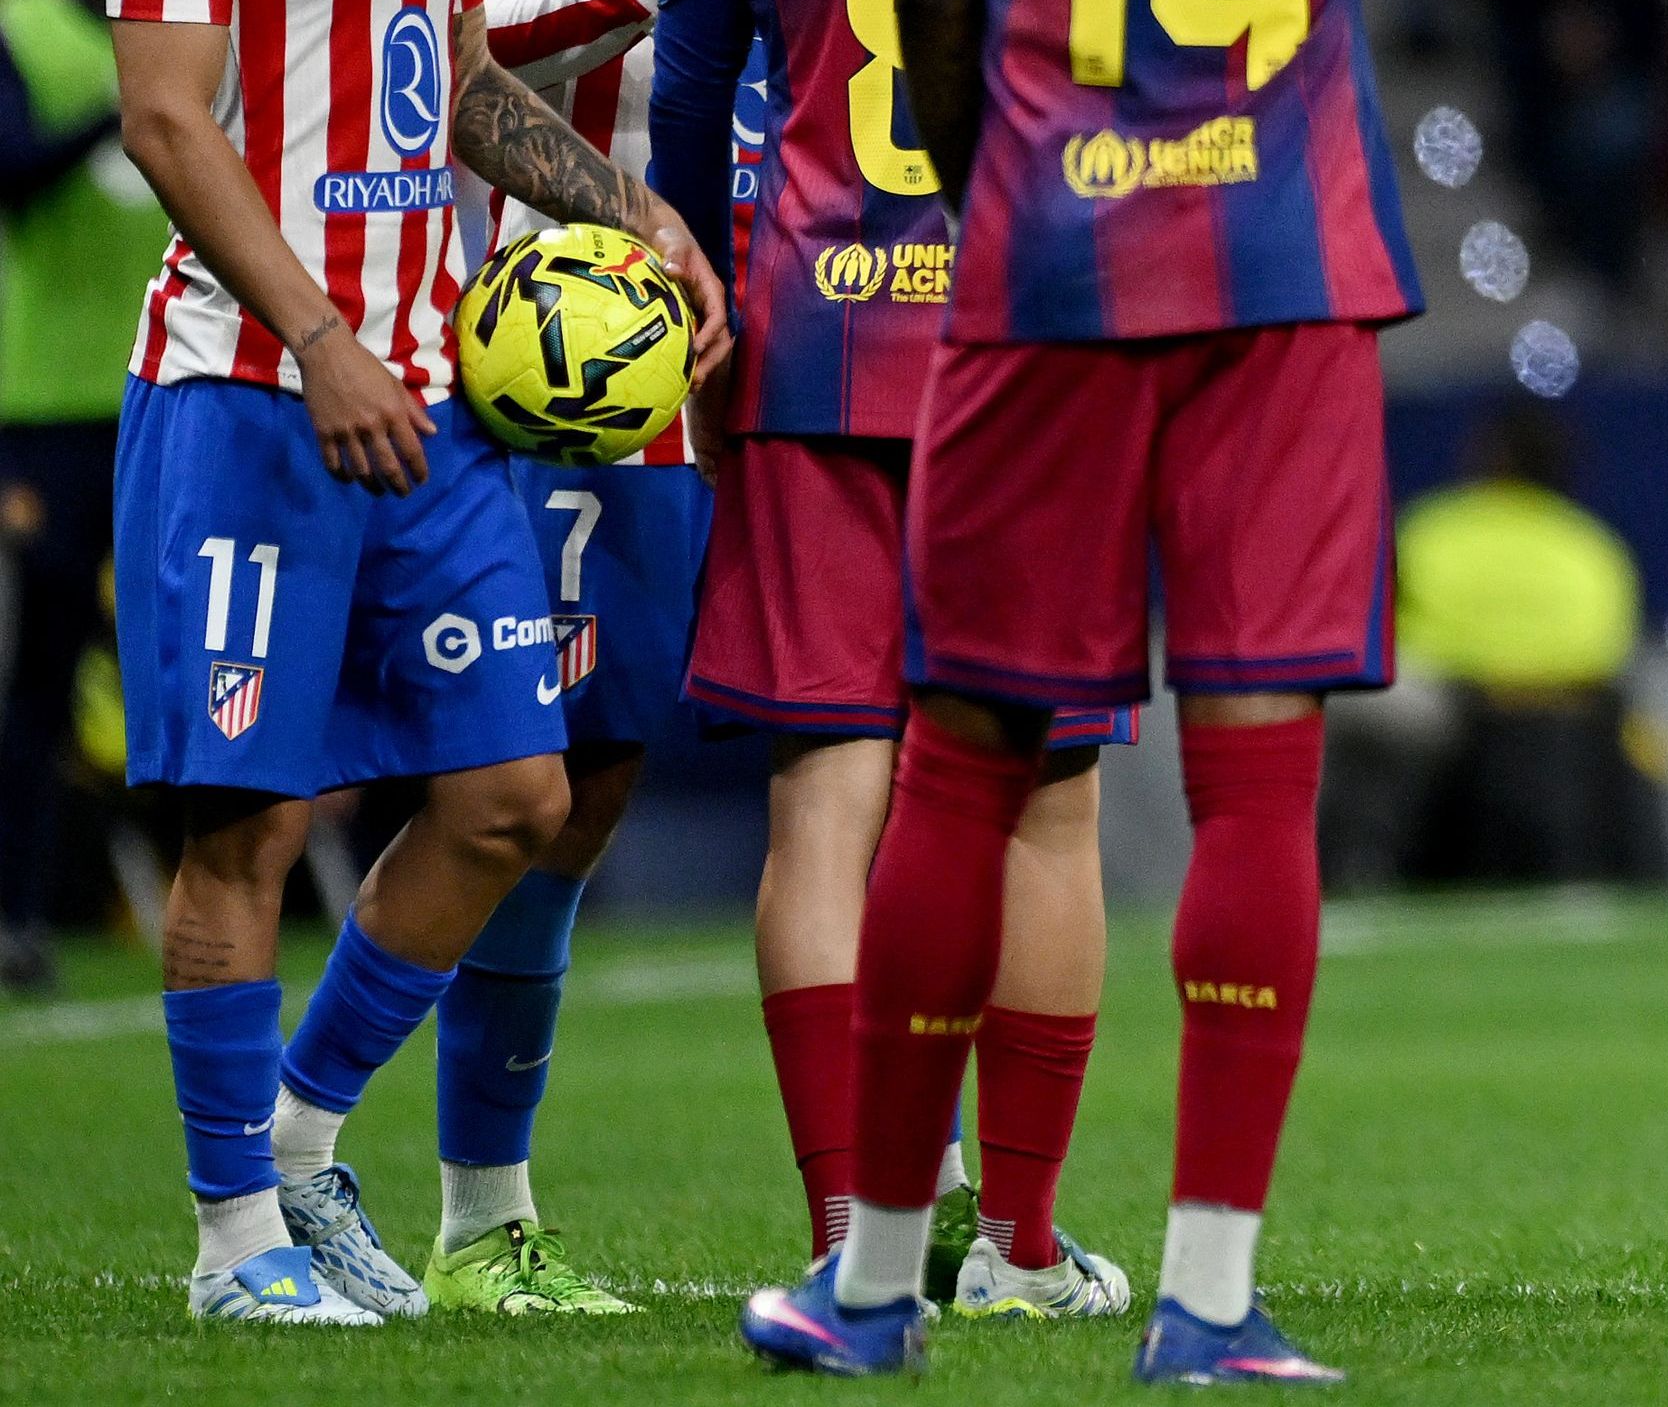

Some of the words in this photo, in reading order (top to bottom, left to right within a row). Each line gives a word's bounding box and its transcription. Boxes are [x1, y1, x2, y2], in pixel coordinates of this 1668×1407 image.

[324, 175, 430, 208] RIYADH
[893, 244, 955, 268] UNH
[890, 268, 951, 292] ACN
[545, 490, 601, 602] 7
[198, 537, 280, 659] 11
[493, 616, 554, 650] Com
